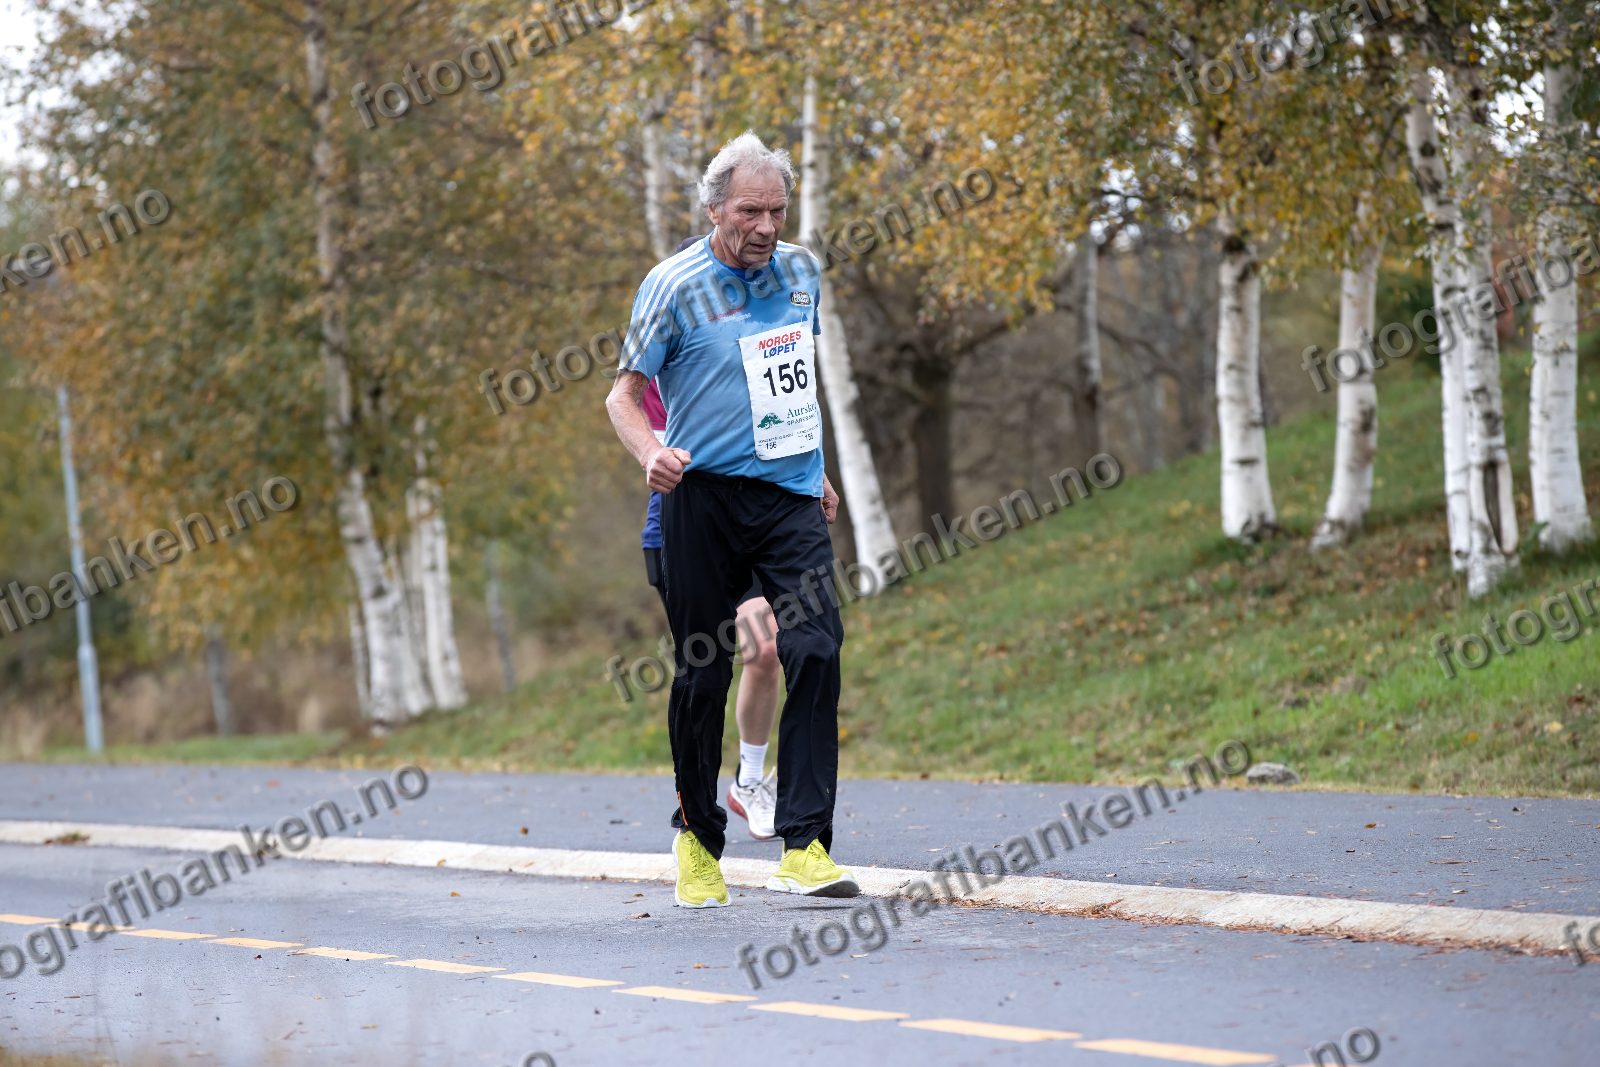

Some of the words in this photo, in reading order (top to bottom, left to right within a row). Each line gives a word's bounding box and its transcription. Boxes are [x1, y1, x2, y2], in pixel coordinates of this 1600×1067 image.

[758, 330, 802, 350] NORGES
[763, 341, 797, 358] LØPET
[763, 358, 808, 397] 156
